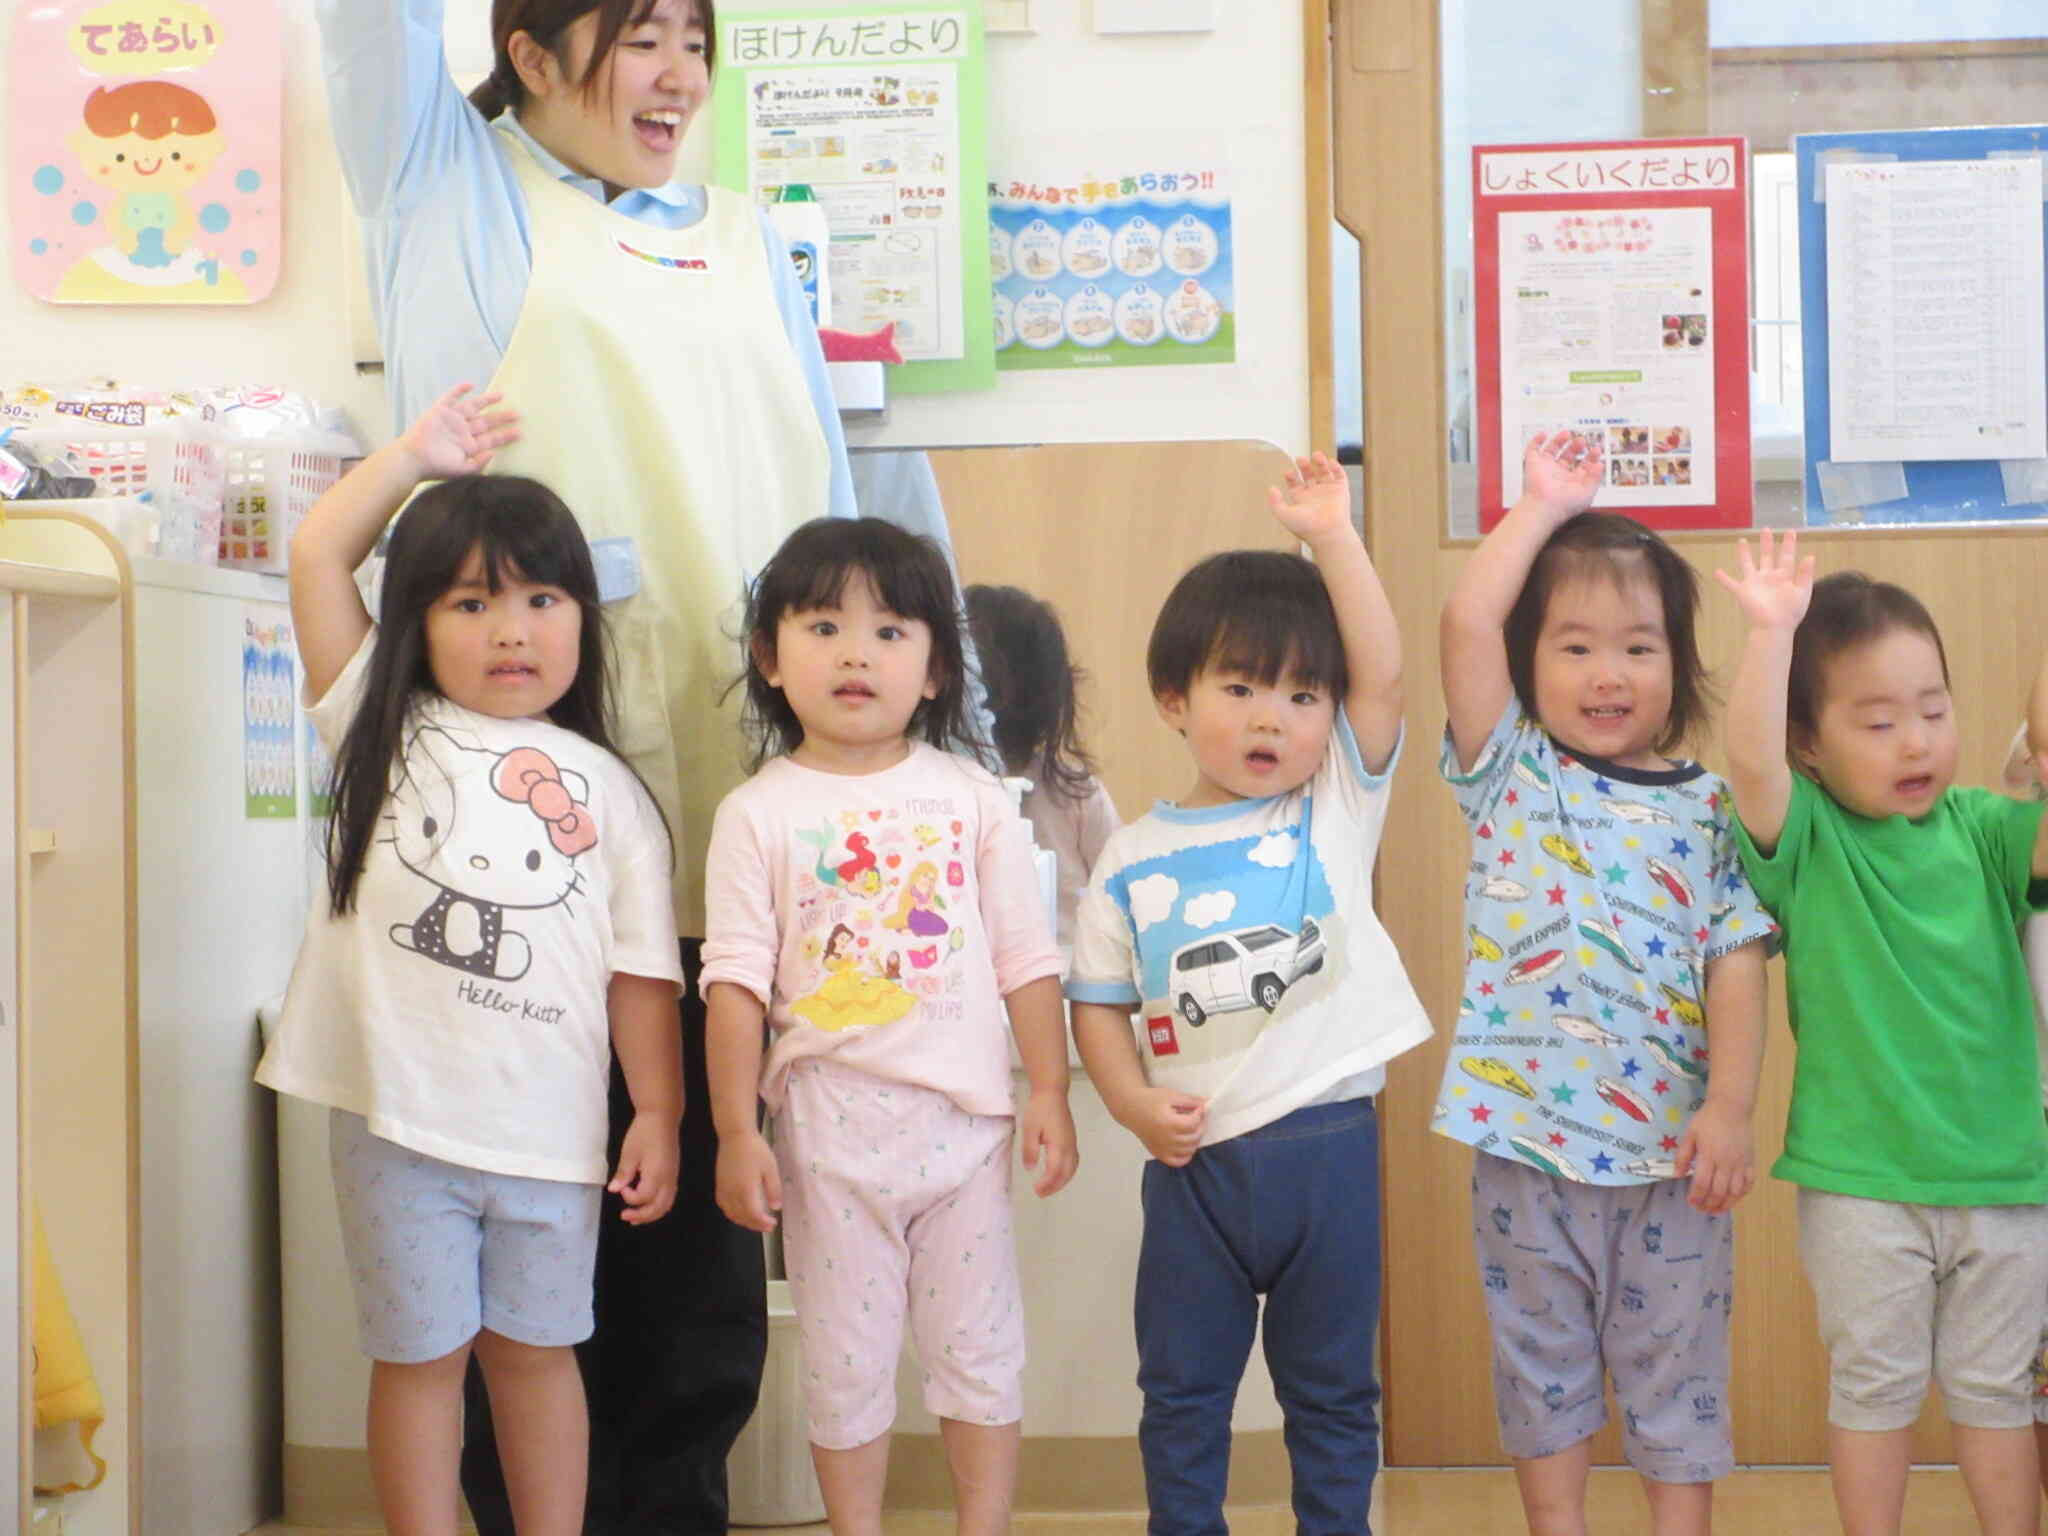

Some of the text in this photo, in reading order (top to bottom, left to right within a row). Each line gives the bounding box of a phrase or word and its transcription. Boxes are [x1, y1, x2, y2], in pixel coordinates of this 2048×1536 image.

[80, 18, 214, 54] てあらい
[733, 18, 960, 60] ほけんだより
[1485, 157, 1731, 191] しょくいくだより
[457, 979, 520, 1012] Hello
